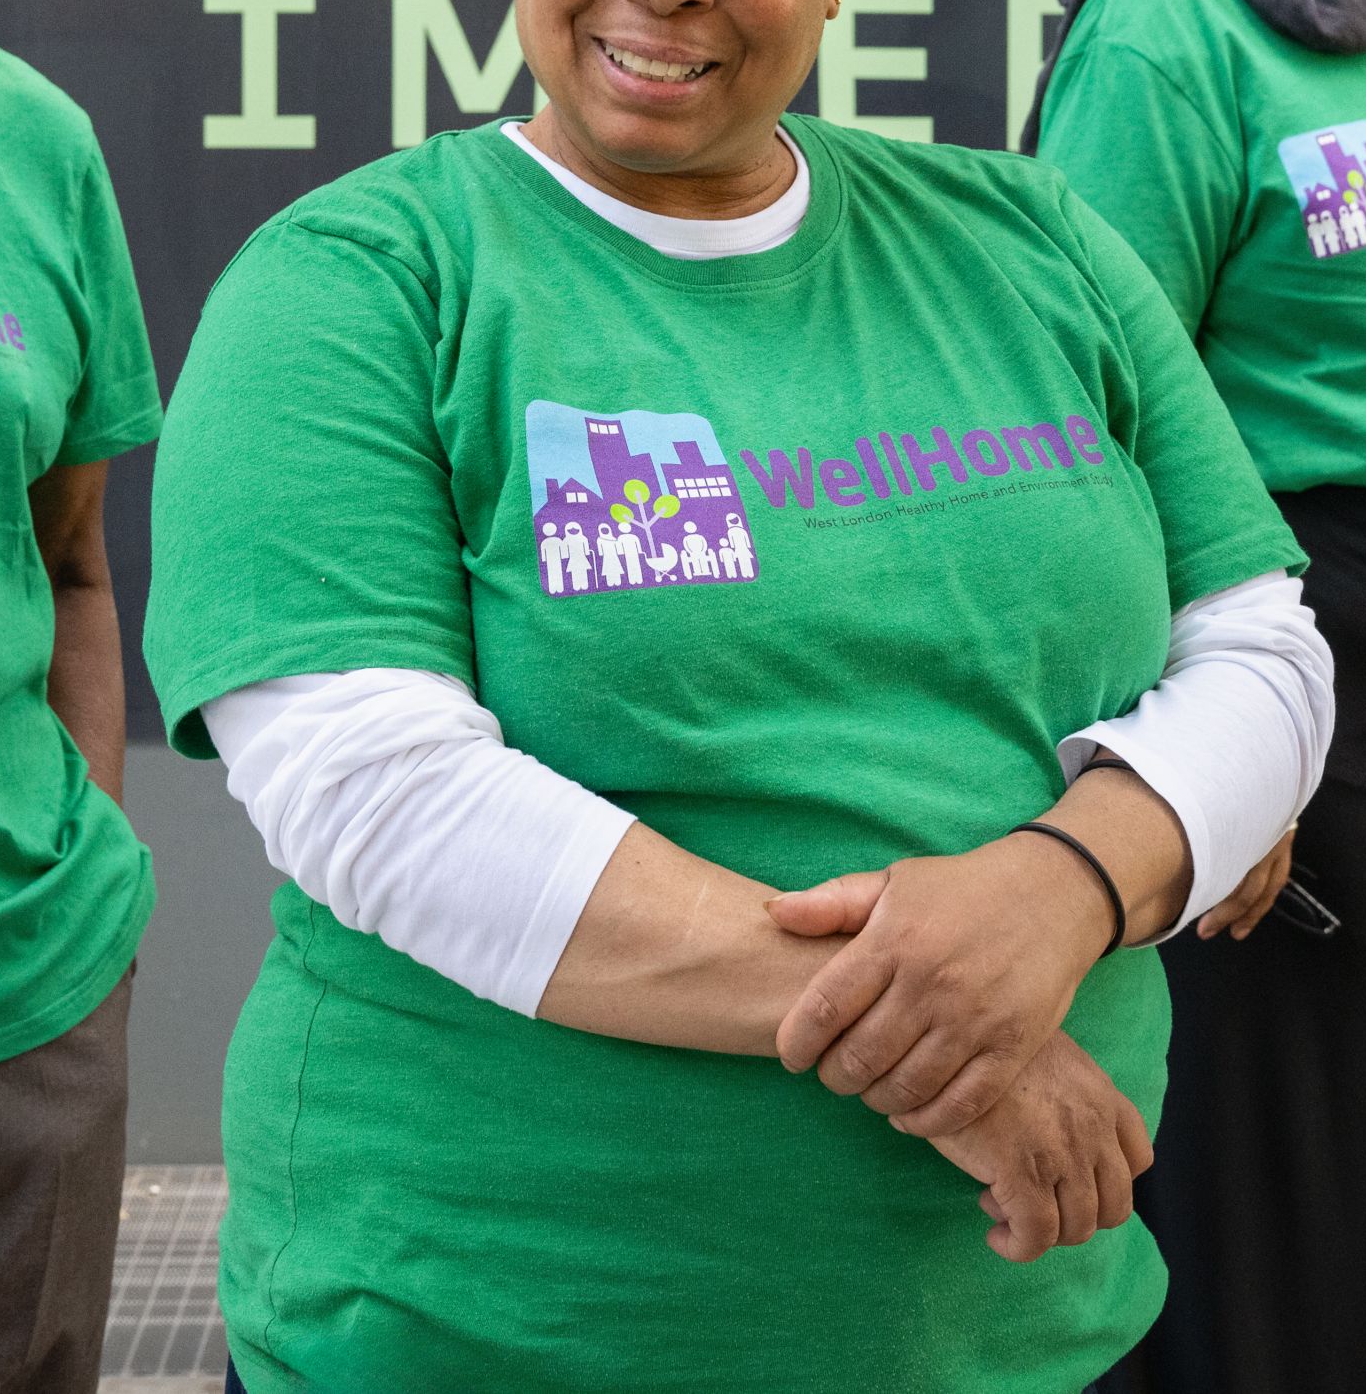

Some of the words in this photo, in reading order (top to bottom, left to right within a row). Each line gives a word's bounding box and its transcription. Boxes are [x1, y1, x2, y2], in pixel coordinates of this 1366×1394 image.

[739, 414, 1104, 510] WellHome
[803, 517, 838, 529] West
[841, 510, 893, 527] London
[896, 501, 946, 517] Healthy
[948, 491, 989, 506] Home
[993, 483, 1017, 498] and
[1019, 476, 1091, 494] Environment
[1090, 472, 1114, 488] Study
